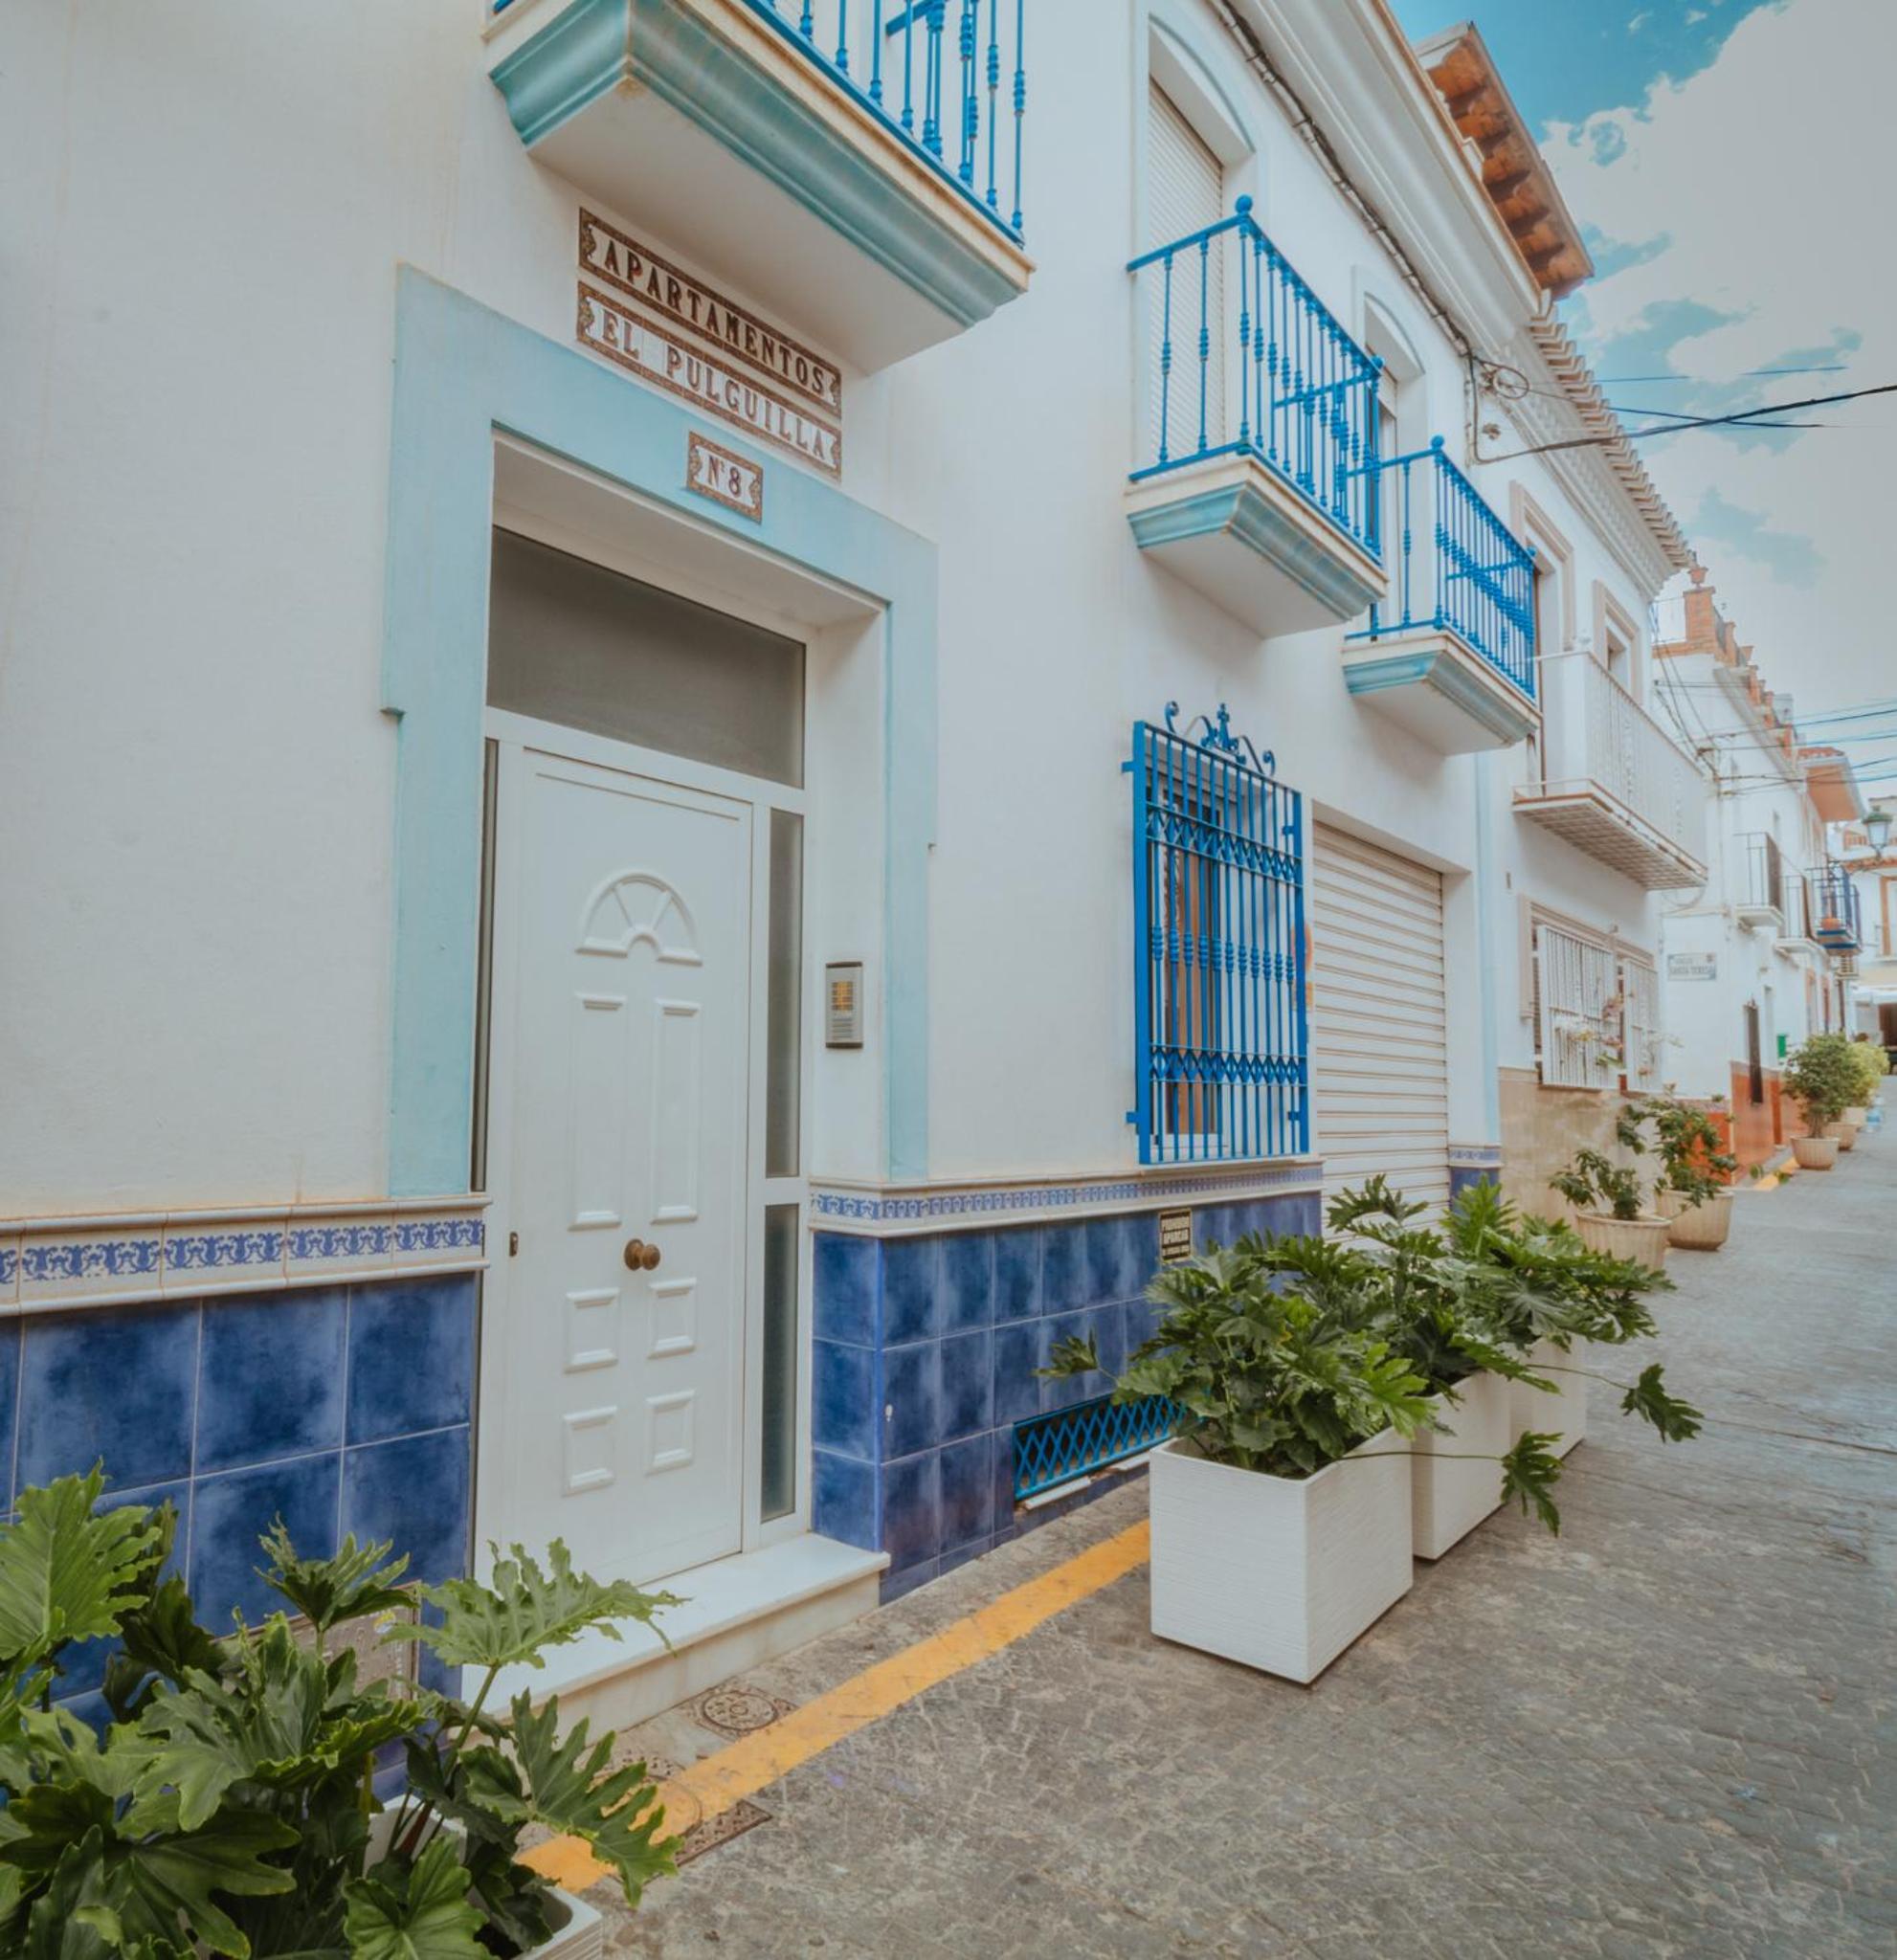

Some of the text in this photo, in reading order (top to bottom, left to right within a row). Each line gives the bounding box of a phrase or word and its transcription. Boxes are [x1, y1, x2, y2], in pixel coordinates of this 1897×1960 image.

[603, 309, 825, 459] EL PULGUILLA
[604, 239, 825, 394] APARTAMENTOS
